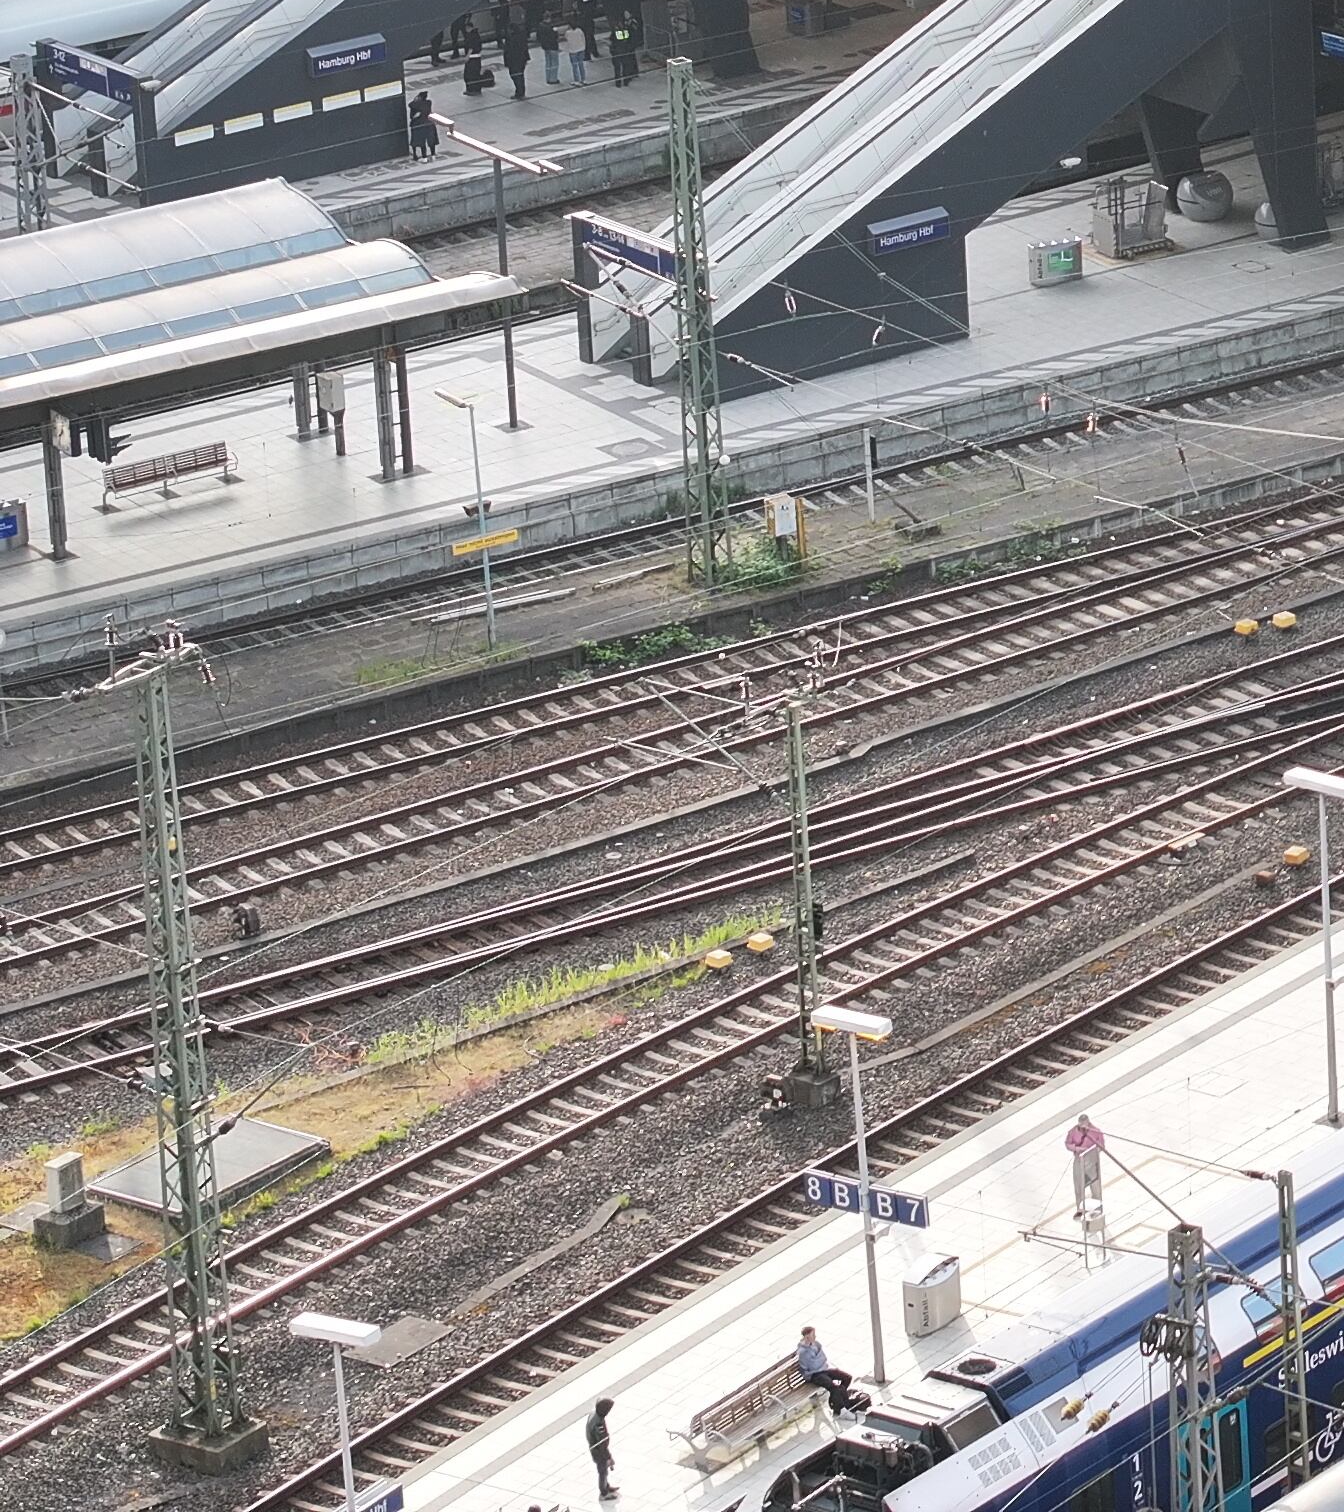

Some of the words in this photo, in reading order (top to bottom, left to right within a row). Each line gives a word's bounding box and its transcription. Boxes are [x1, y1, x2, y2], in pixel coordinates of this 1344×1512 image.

[319, 53, 355, 71] Hamburg
[356, 49, 371, 63] Hbf
[880, 231, 917, 248] Hamburg
[919, 225, 934, 238] Hbf
[807, 1176, 822, 1201] 8
[834, 1183, 850, 1208] B
[877, 1192, 893, 1217] B
[906, 1199, 919, 1222] 7
[1132, 1454, 1139, 1471] 1
[1133, 1480, 1142, 1502] 2
